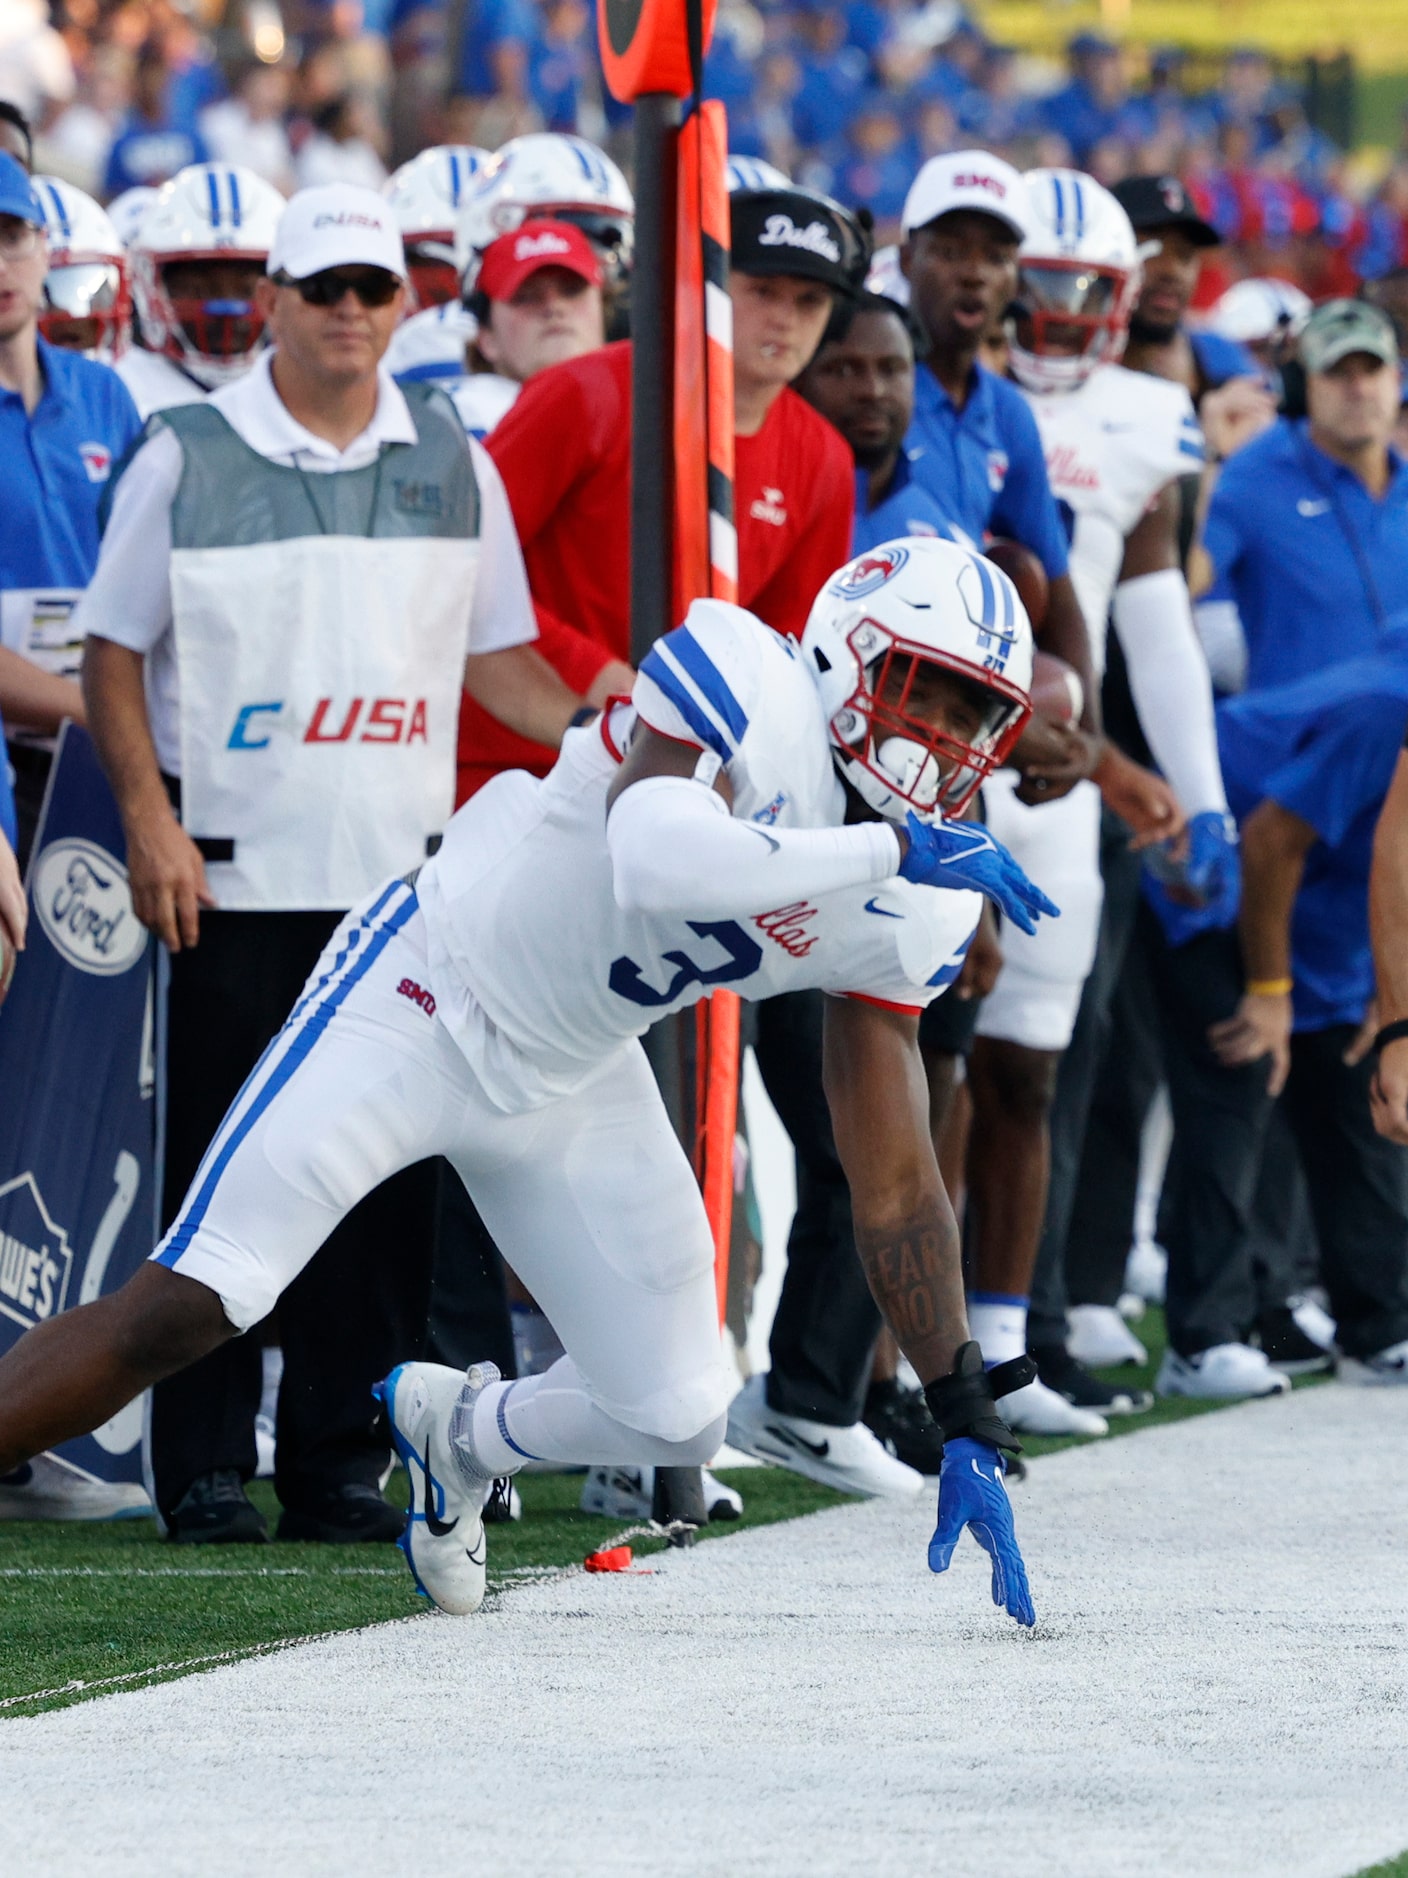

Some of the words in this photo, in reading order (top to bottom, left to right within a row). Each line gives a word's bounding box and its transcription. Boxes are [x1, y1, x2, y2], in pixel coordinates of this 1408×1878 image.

[303, 697, 427, 744] USA
[53, 857, 124, 955] Ford
[396, 977, 437, 1018] SMU
[608, 919, 763, 1007] 3
[0, 1230, 60, 1320] WE'S
